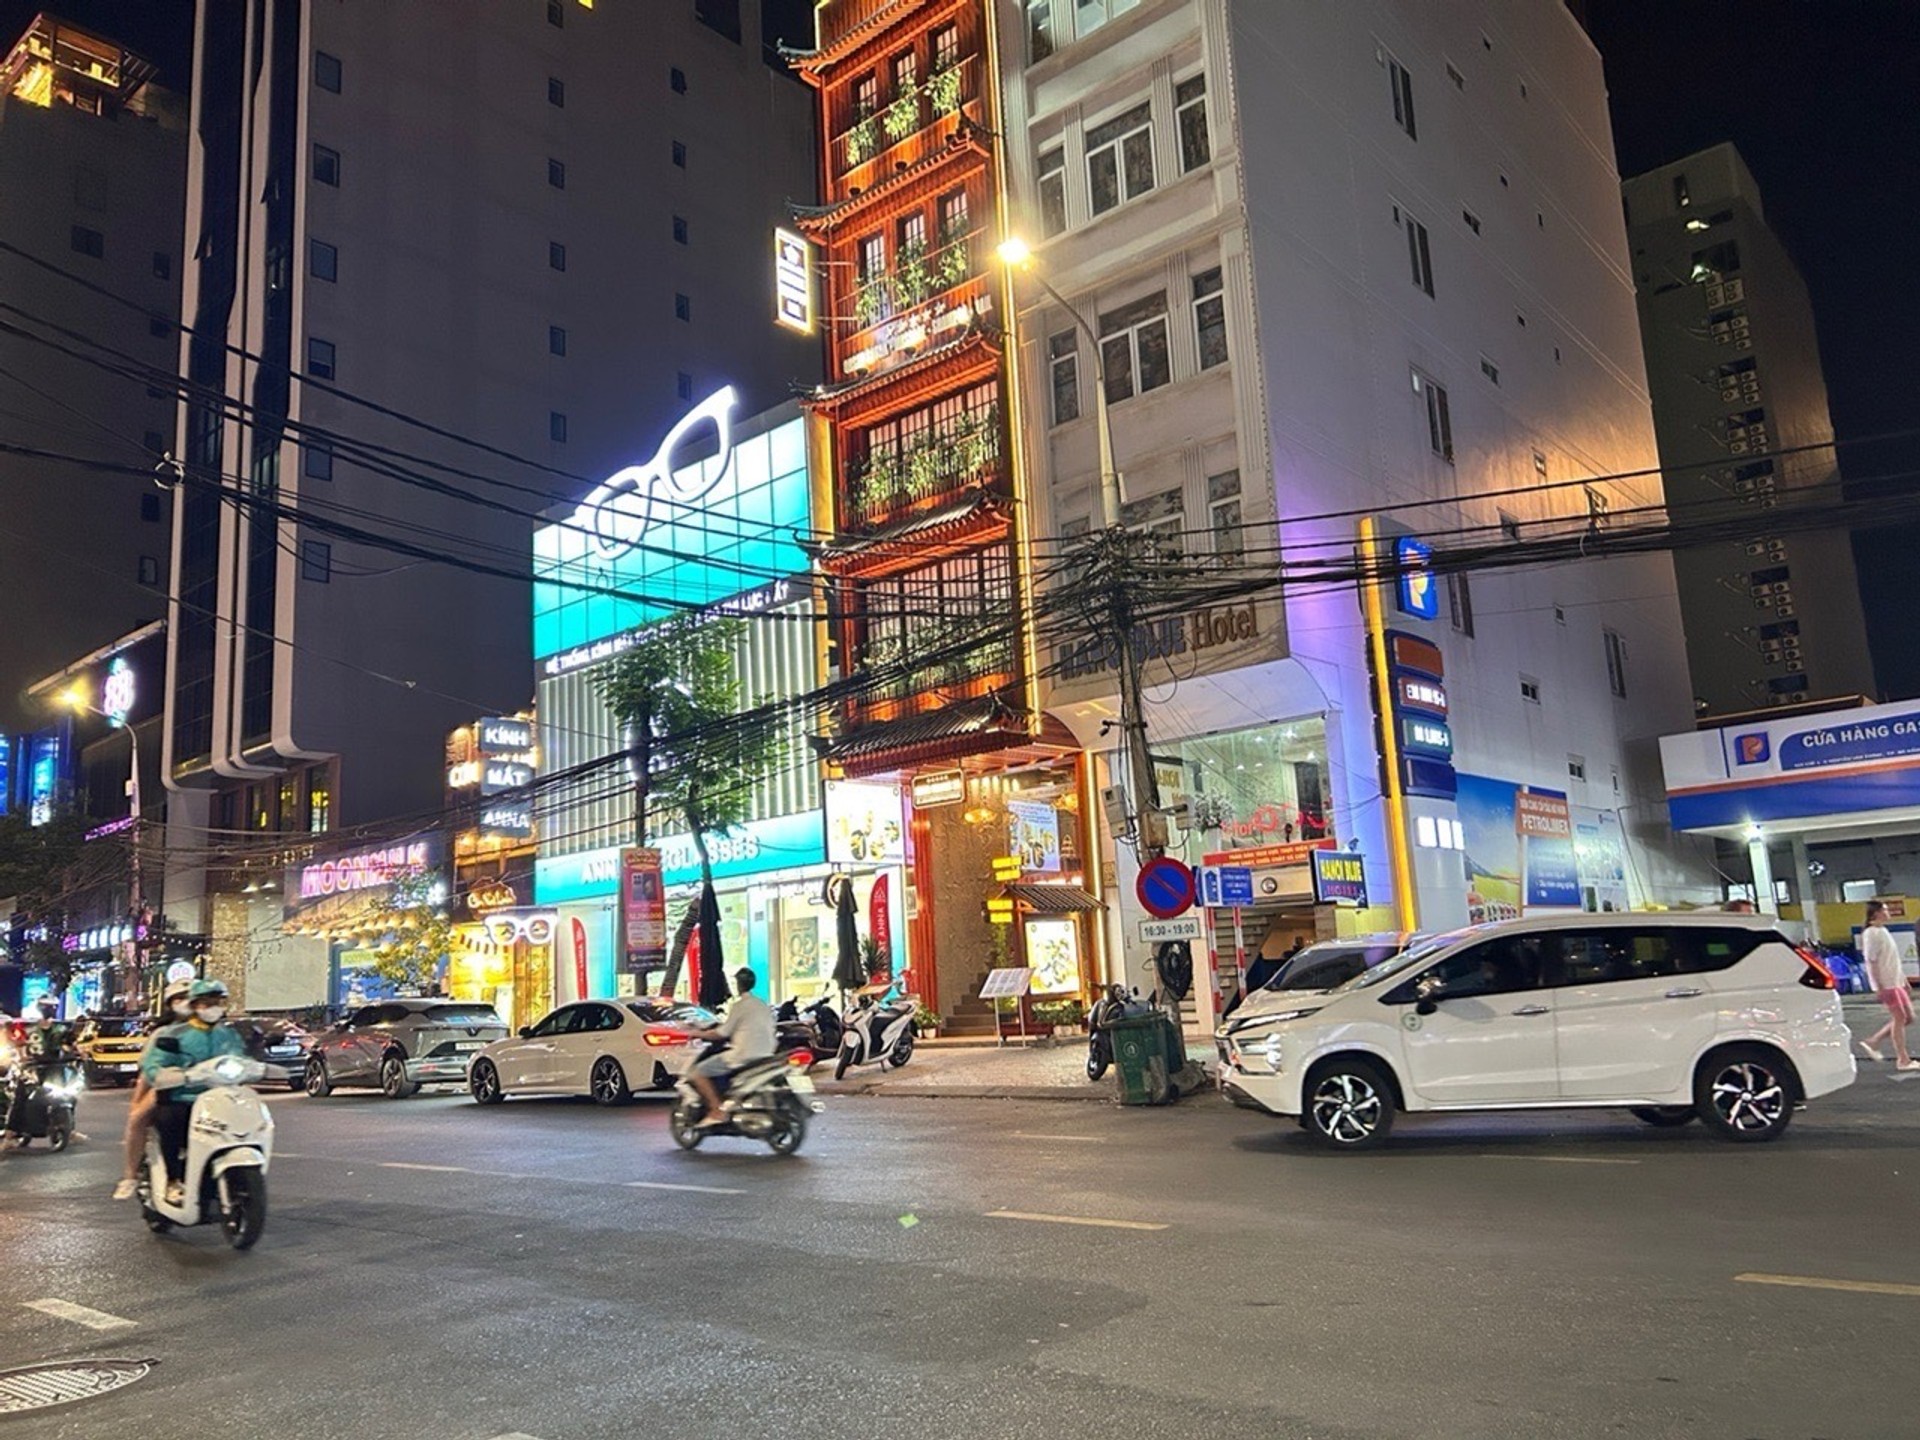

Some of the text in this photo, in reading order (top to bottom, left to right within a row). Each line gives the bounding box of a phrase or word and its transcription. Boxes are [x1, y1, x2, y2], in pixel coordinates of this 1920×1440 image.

[1190, 596, 1260, 652] Hotel
[485, 725, 527, 747] KÍNH
[1802, 730, 1836, 748] CỬA
[1841, 724, 1889, 743] HÀNG
